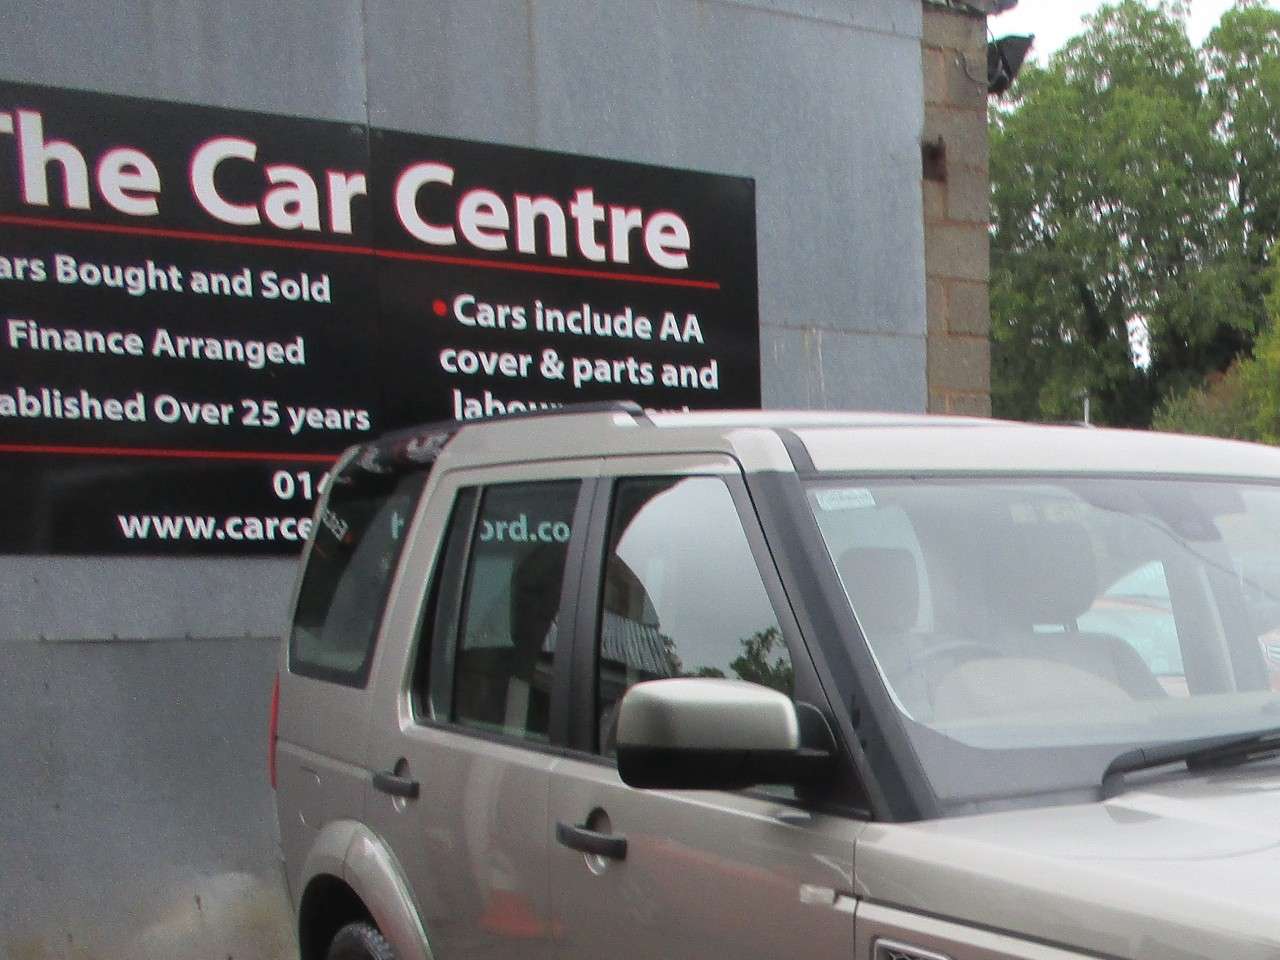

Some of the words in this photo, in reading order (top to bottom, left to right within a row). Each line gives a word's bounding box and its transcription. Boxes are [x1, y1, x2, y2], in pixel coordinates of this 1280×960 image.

[0, 108, 162, 217] he
[190, 135, 368, 236] Car
[394, 160, 692, 270] Centre
[0, 255, 47, 282] ars
[54, 253, 184, 297] Bought
[190, 267, 253, 298] and
[260, 270, 332, 304] Sold
[6, 318, 145, 356] Finance
[151, 328, 306, 370] Arranged
[453, 294, 527, 331] Cars
[535, 299, 652, 340] include
[659, 311, 705, 344] AA
[439, 347, 533, 379] cover
[540, 348, 566, 380] &
[572, 357, 655, 388] parts
[661, 359, 719, 390] and
[0, 386, 147, 422] ablished
[153, 394, 234, 426] Over
[241, 398, 281, 429] 25
[286, 406, 372, 435] years
